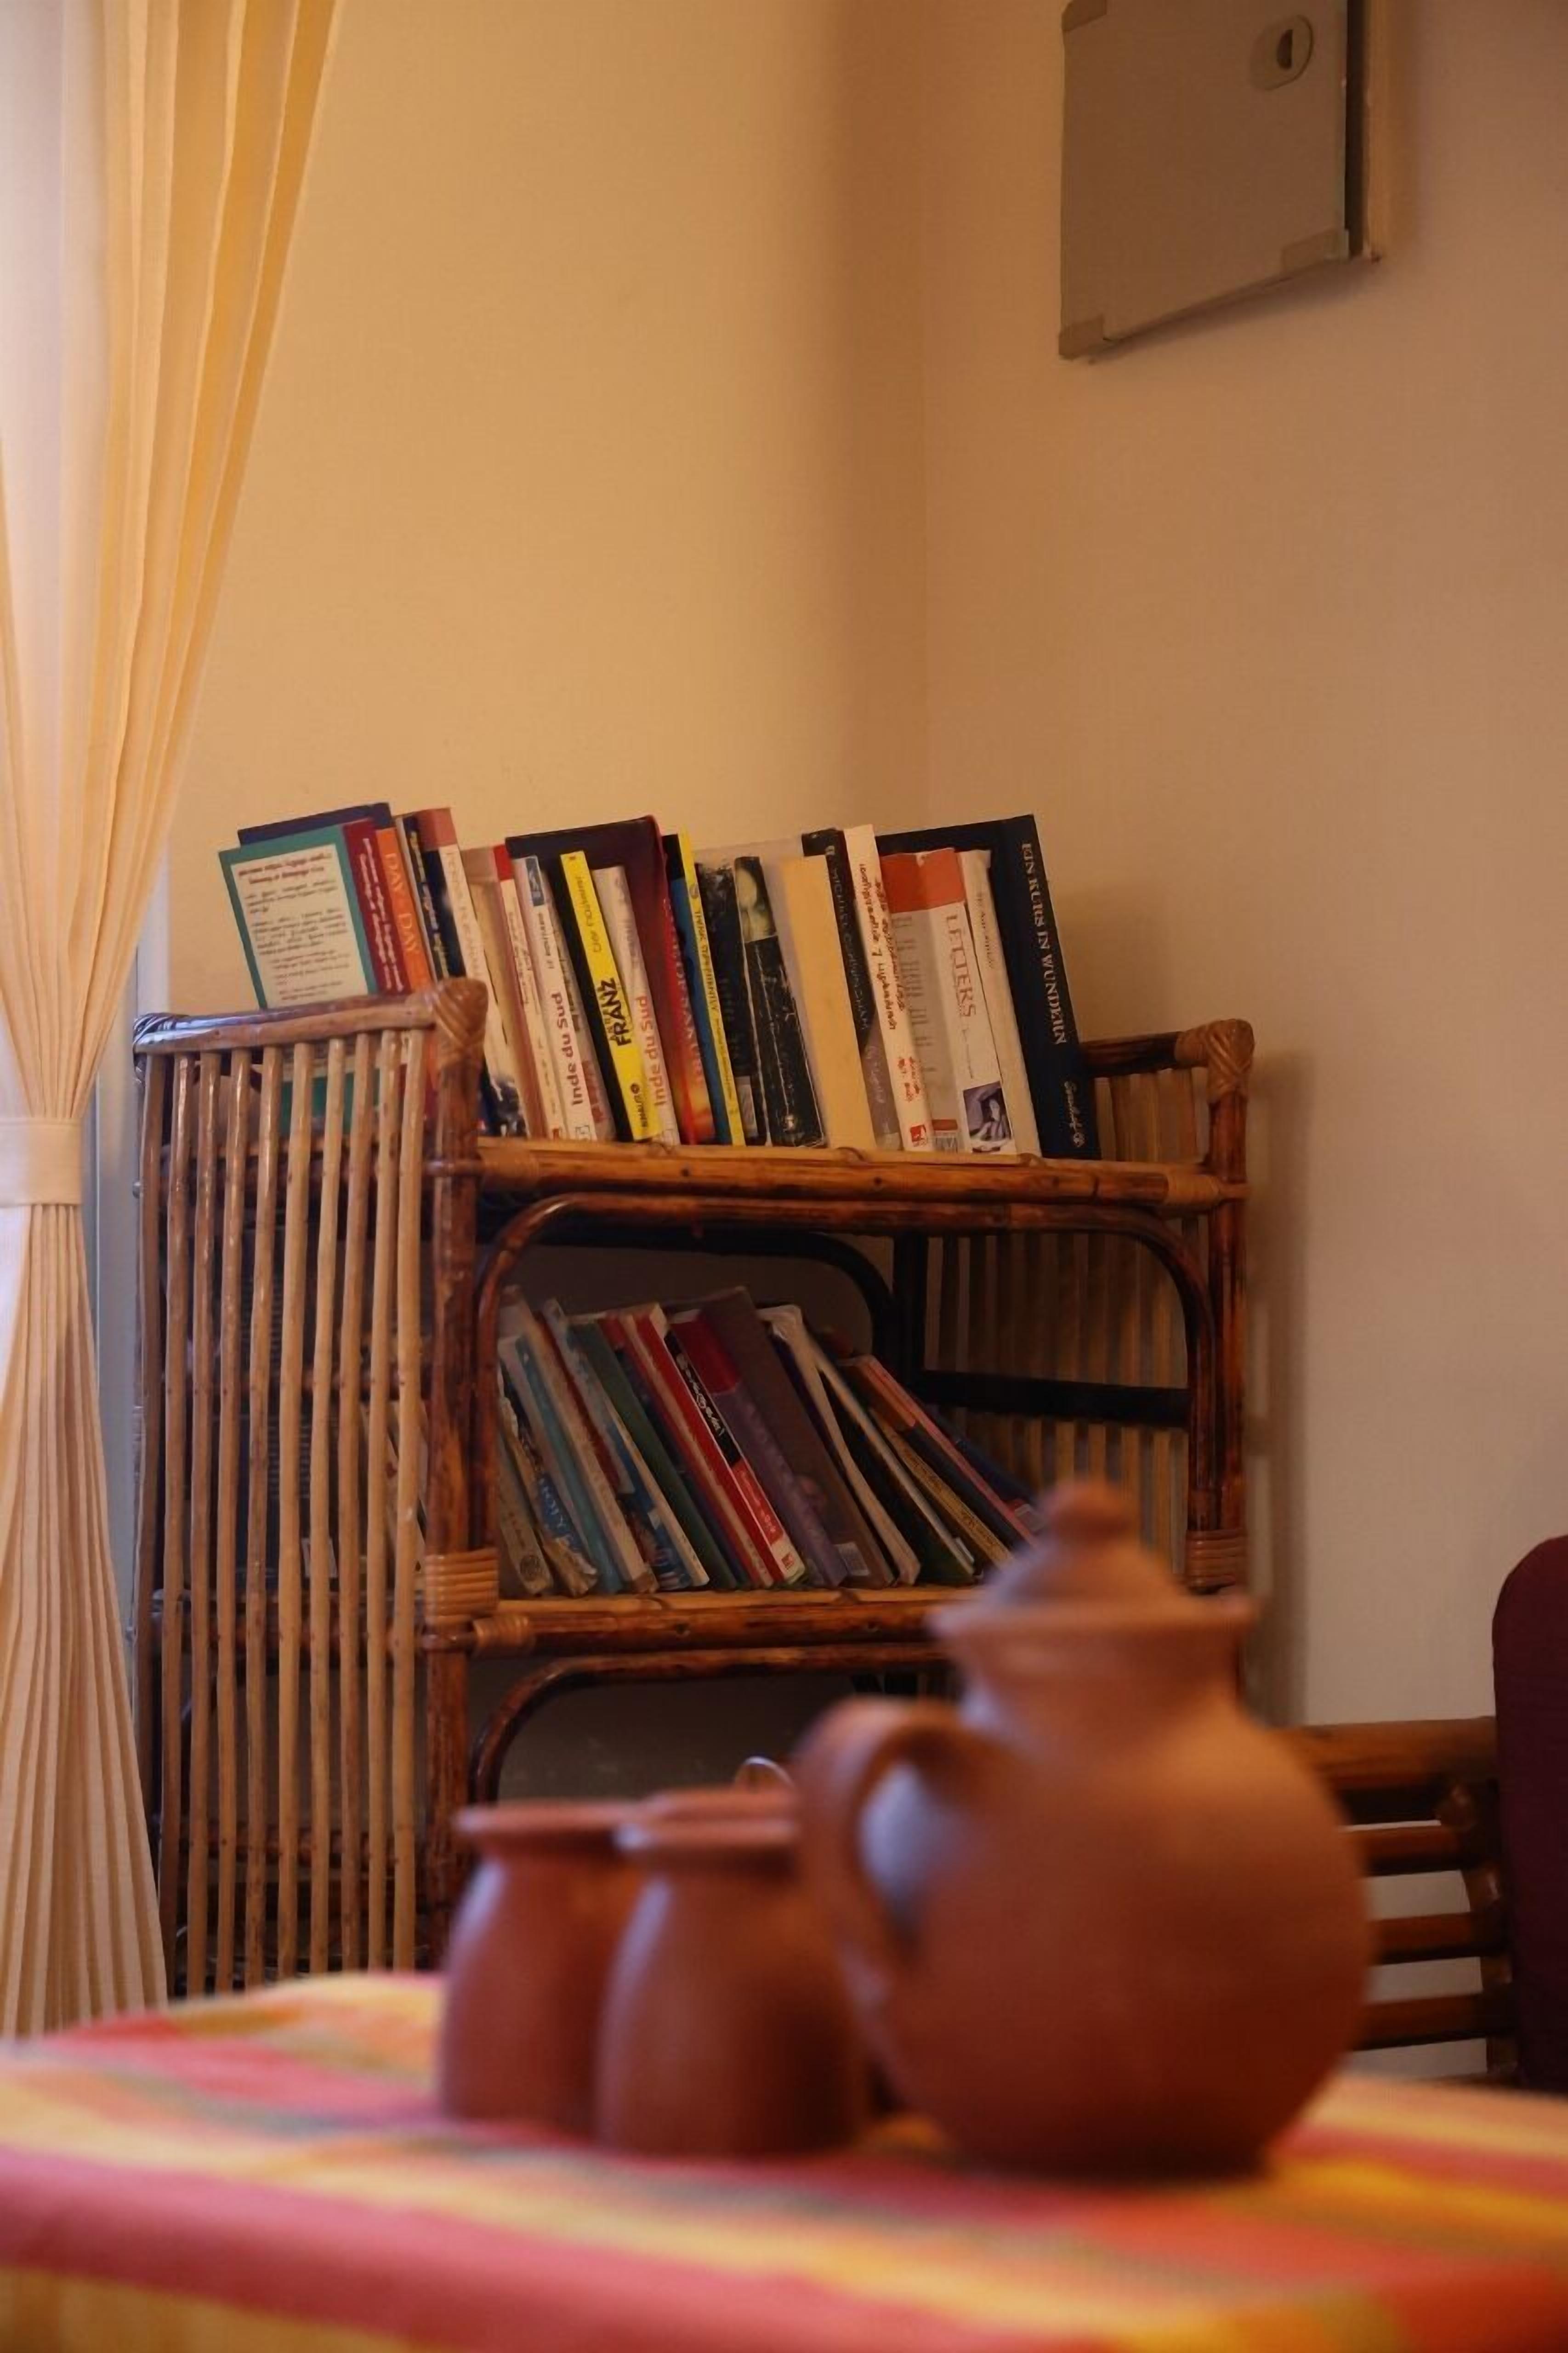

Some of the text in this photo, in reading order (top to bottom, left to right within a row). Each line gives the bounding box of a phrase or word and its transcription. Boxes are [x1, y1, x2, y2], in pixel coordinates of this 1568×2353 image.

[946, 915, 976, 1017] LETTERS
[1022, 843, 1067, 1044] EIN KURS IN WUNDERN
[551, 992, 568, 1030] Sud
[602, 978, 631, 1047] FRANZ
[562, 1034, 574, 1058] du
[636, 996, 666, 1106] Inde du Sud
[566, 1062, 584, 1106] Inde
